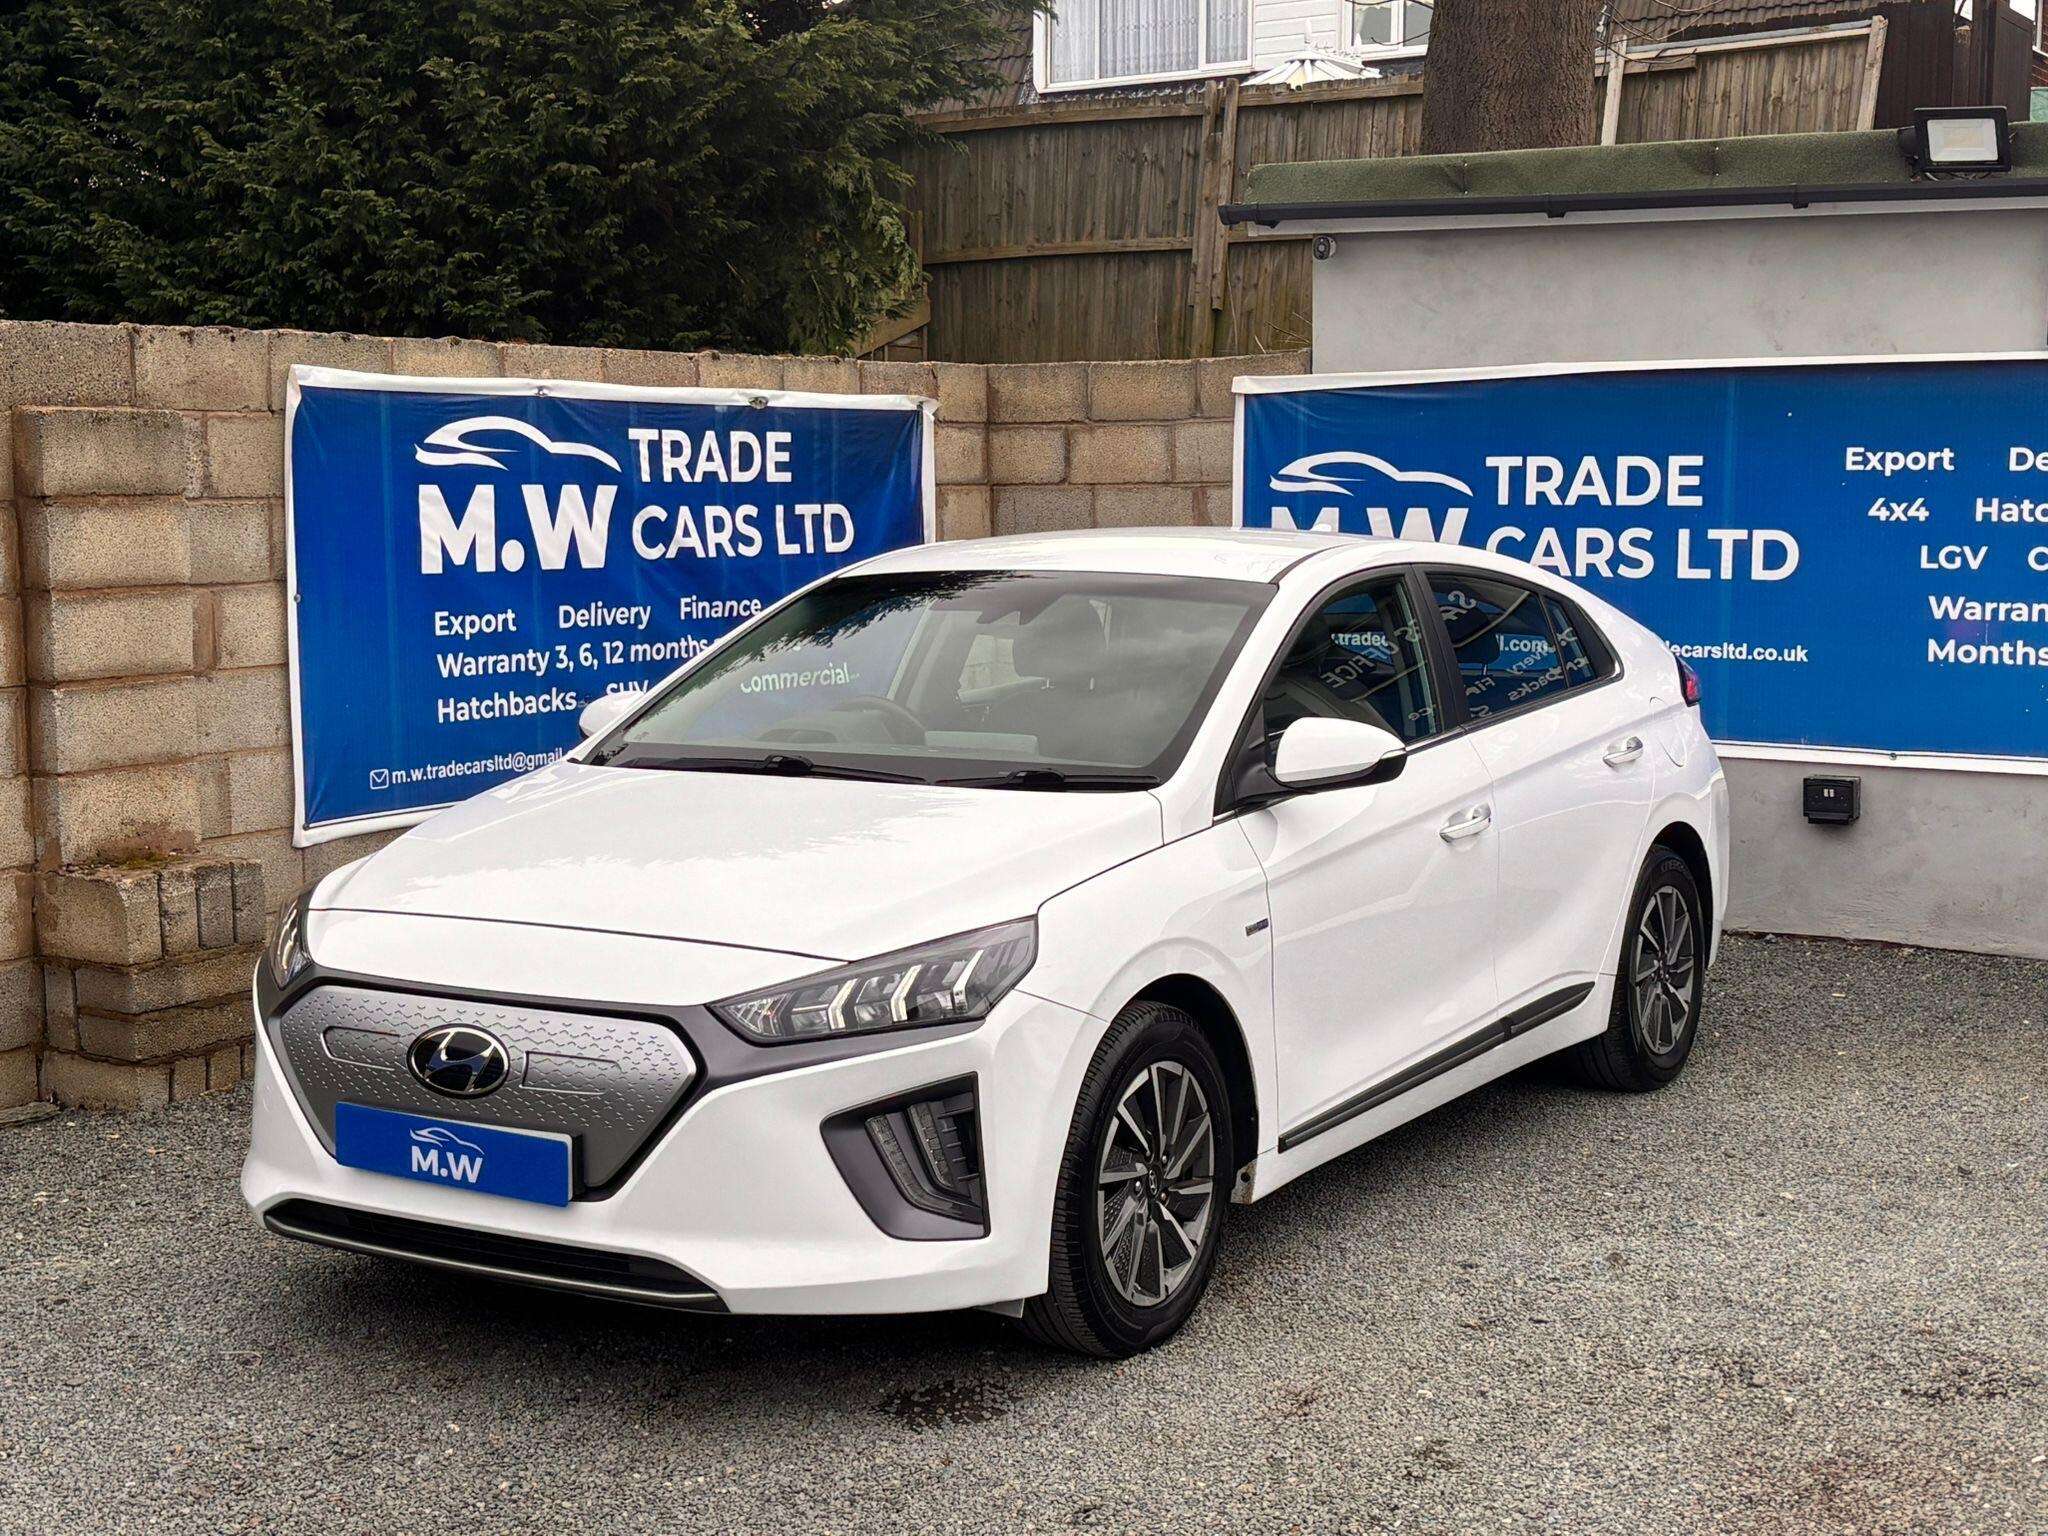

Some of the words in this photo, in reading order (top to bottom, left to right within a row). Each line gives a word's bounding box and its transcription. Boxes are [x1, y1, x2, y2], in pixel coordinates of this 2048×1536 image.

[628, 428, 792, 483] TRADE
[1845, 446, 1955, 477] Export
[1485, 455, 1703, 507] TRADE
[418, 484, 618, 575] M.W
[1867, 497, 1930, 522] 4x4
[631, 503, 763, 561] CARS
[775, 503, 855, 556] LTD
[1485, 526, 1655, 579] CARS
[1676, 528, 1801, 581] LTD
[1920, 545, 1988, 570] LGV
[434, 608, 517, 640] Export
[558, 600, 651, 629] Delivery
[679, 595, 762, 620] Finance
[436, 649, 550, 678] Warranty
[555, 645, 574, 672] 3,
[579, 642, 599, 670] 6,
[602, 640, 624, 665] 12
[630, 634, 709, 662] months
[1665, 641, 1809, 662] ecarsltd.co.uk
[1928, 638, 2048, 667] Months
[437, 687, 577, 723] Hatchbacks
[411, 1145, 483, 1183] M.W
